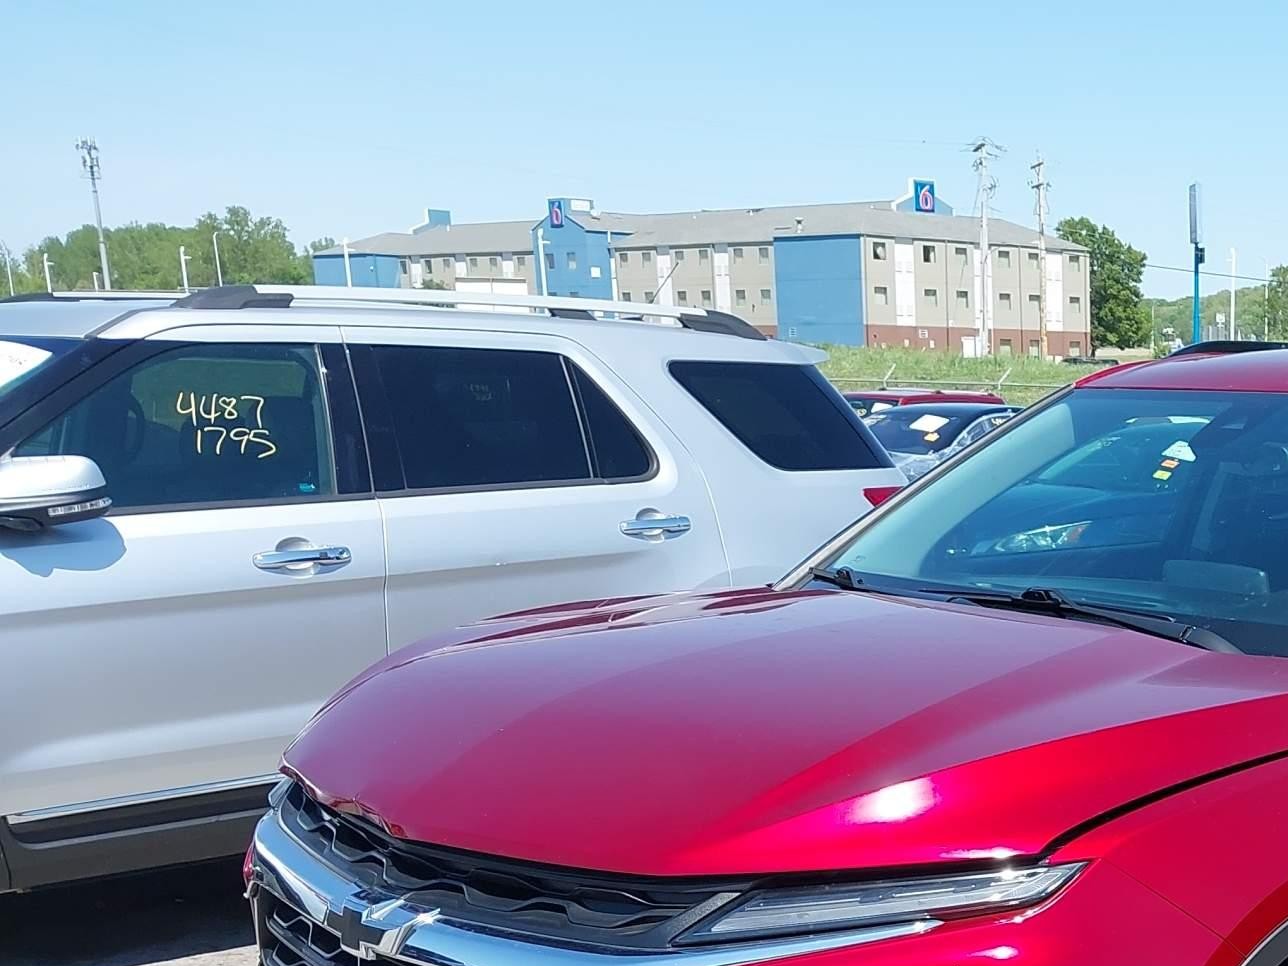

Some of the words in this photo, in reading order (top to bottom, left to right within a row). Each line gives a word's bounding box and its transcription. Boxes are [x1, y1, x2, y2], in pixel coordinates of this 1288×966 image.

[919, 184, 933, 210] 6
[176, 391, 265, 429] 4487
[197, 426, 277, 459] 1795
